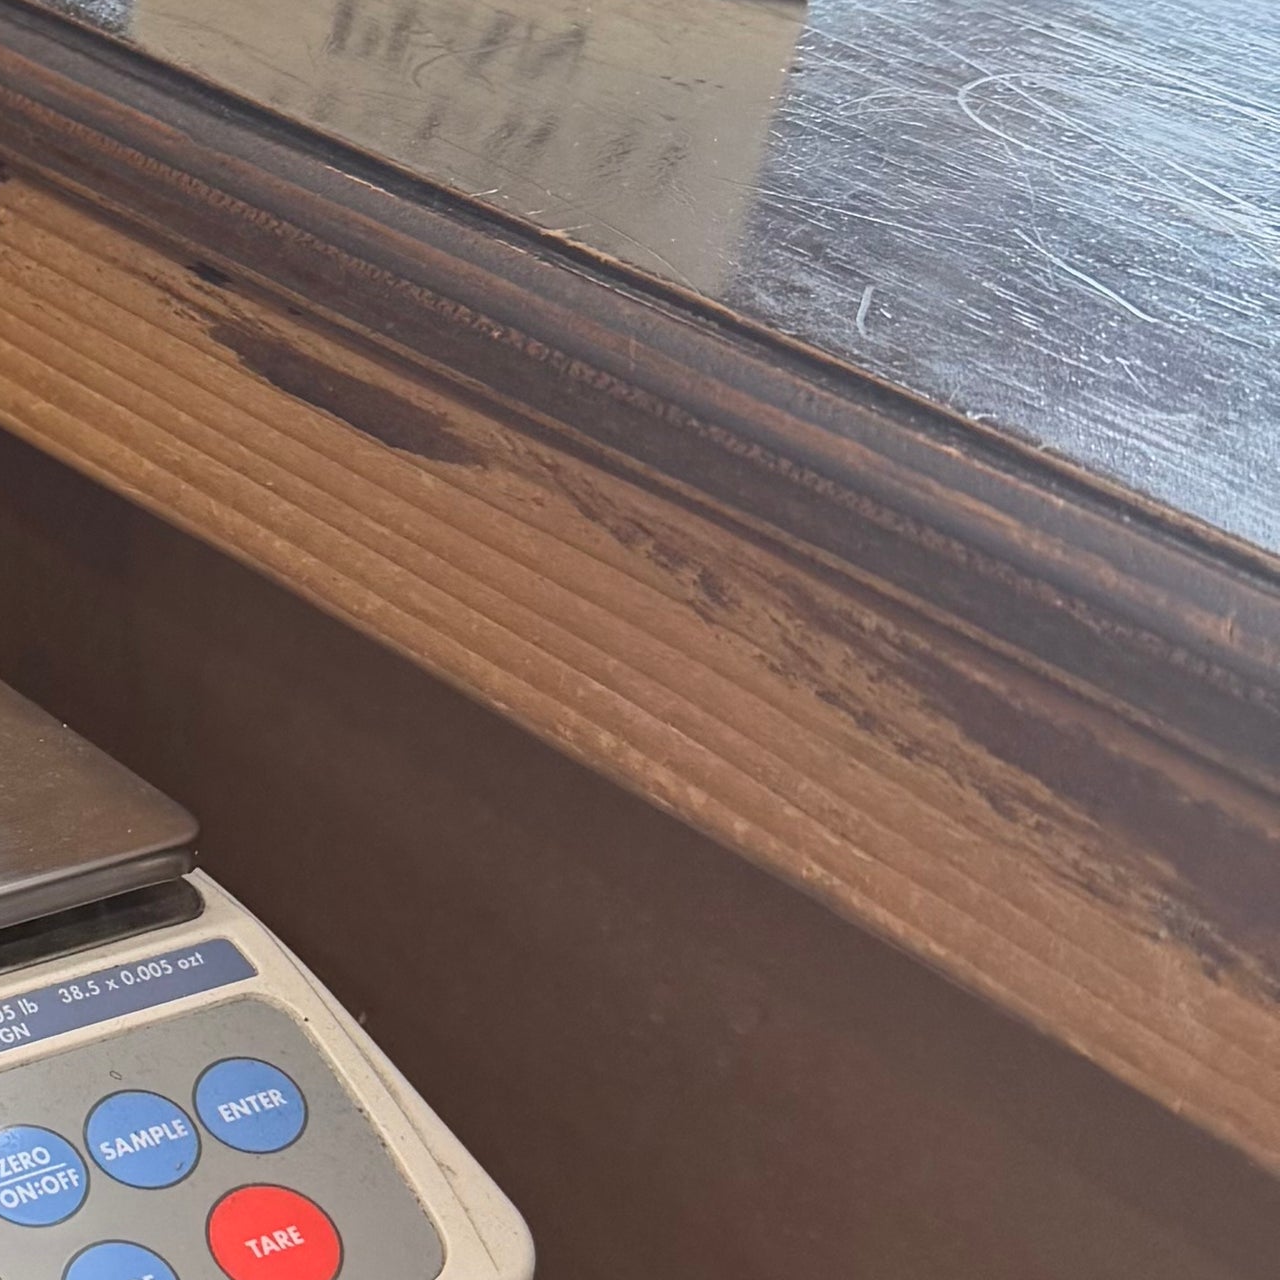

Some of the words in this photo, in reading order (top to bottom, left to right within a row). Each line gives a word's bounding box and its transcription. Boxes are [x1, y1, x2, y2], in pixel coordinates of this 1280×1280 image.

[57, 976, 102, 1005] 38.5
[105, 977, 120, 991] x
[119, 959, 174, 987] 0.005
[176, 951, 206, 971] ozt
[19, 997, 40, 1016] lb
[0, 1021, 32, 1046] GN
[217, 1088, 289, 1124] ENTER
[99, 1118, 190, 1162] SAMPLE
[243, 1225, 306, 1261] TARE
